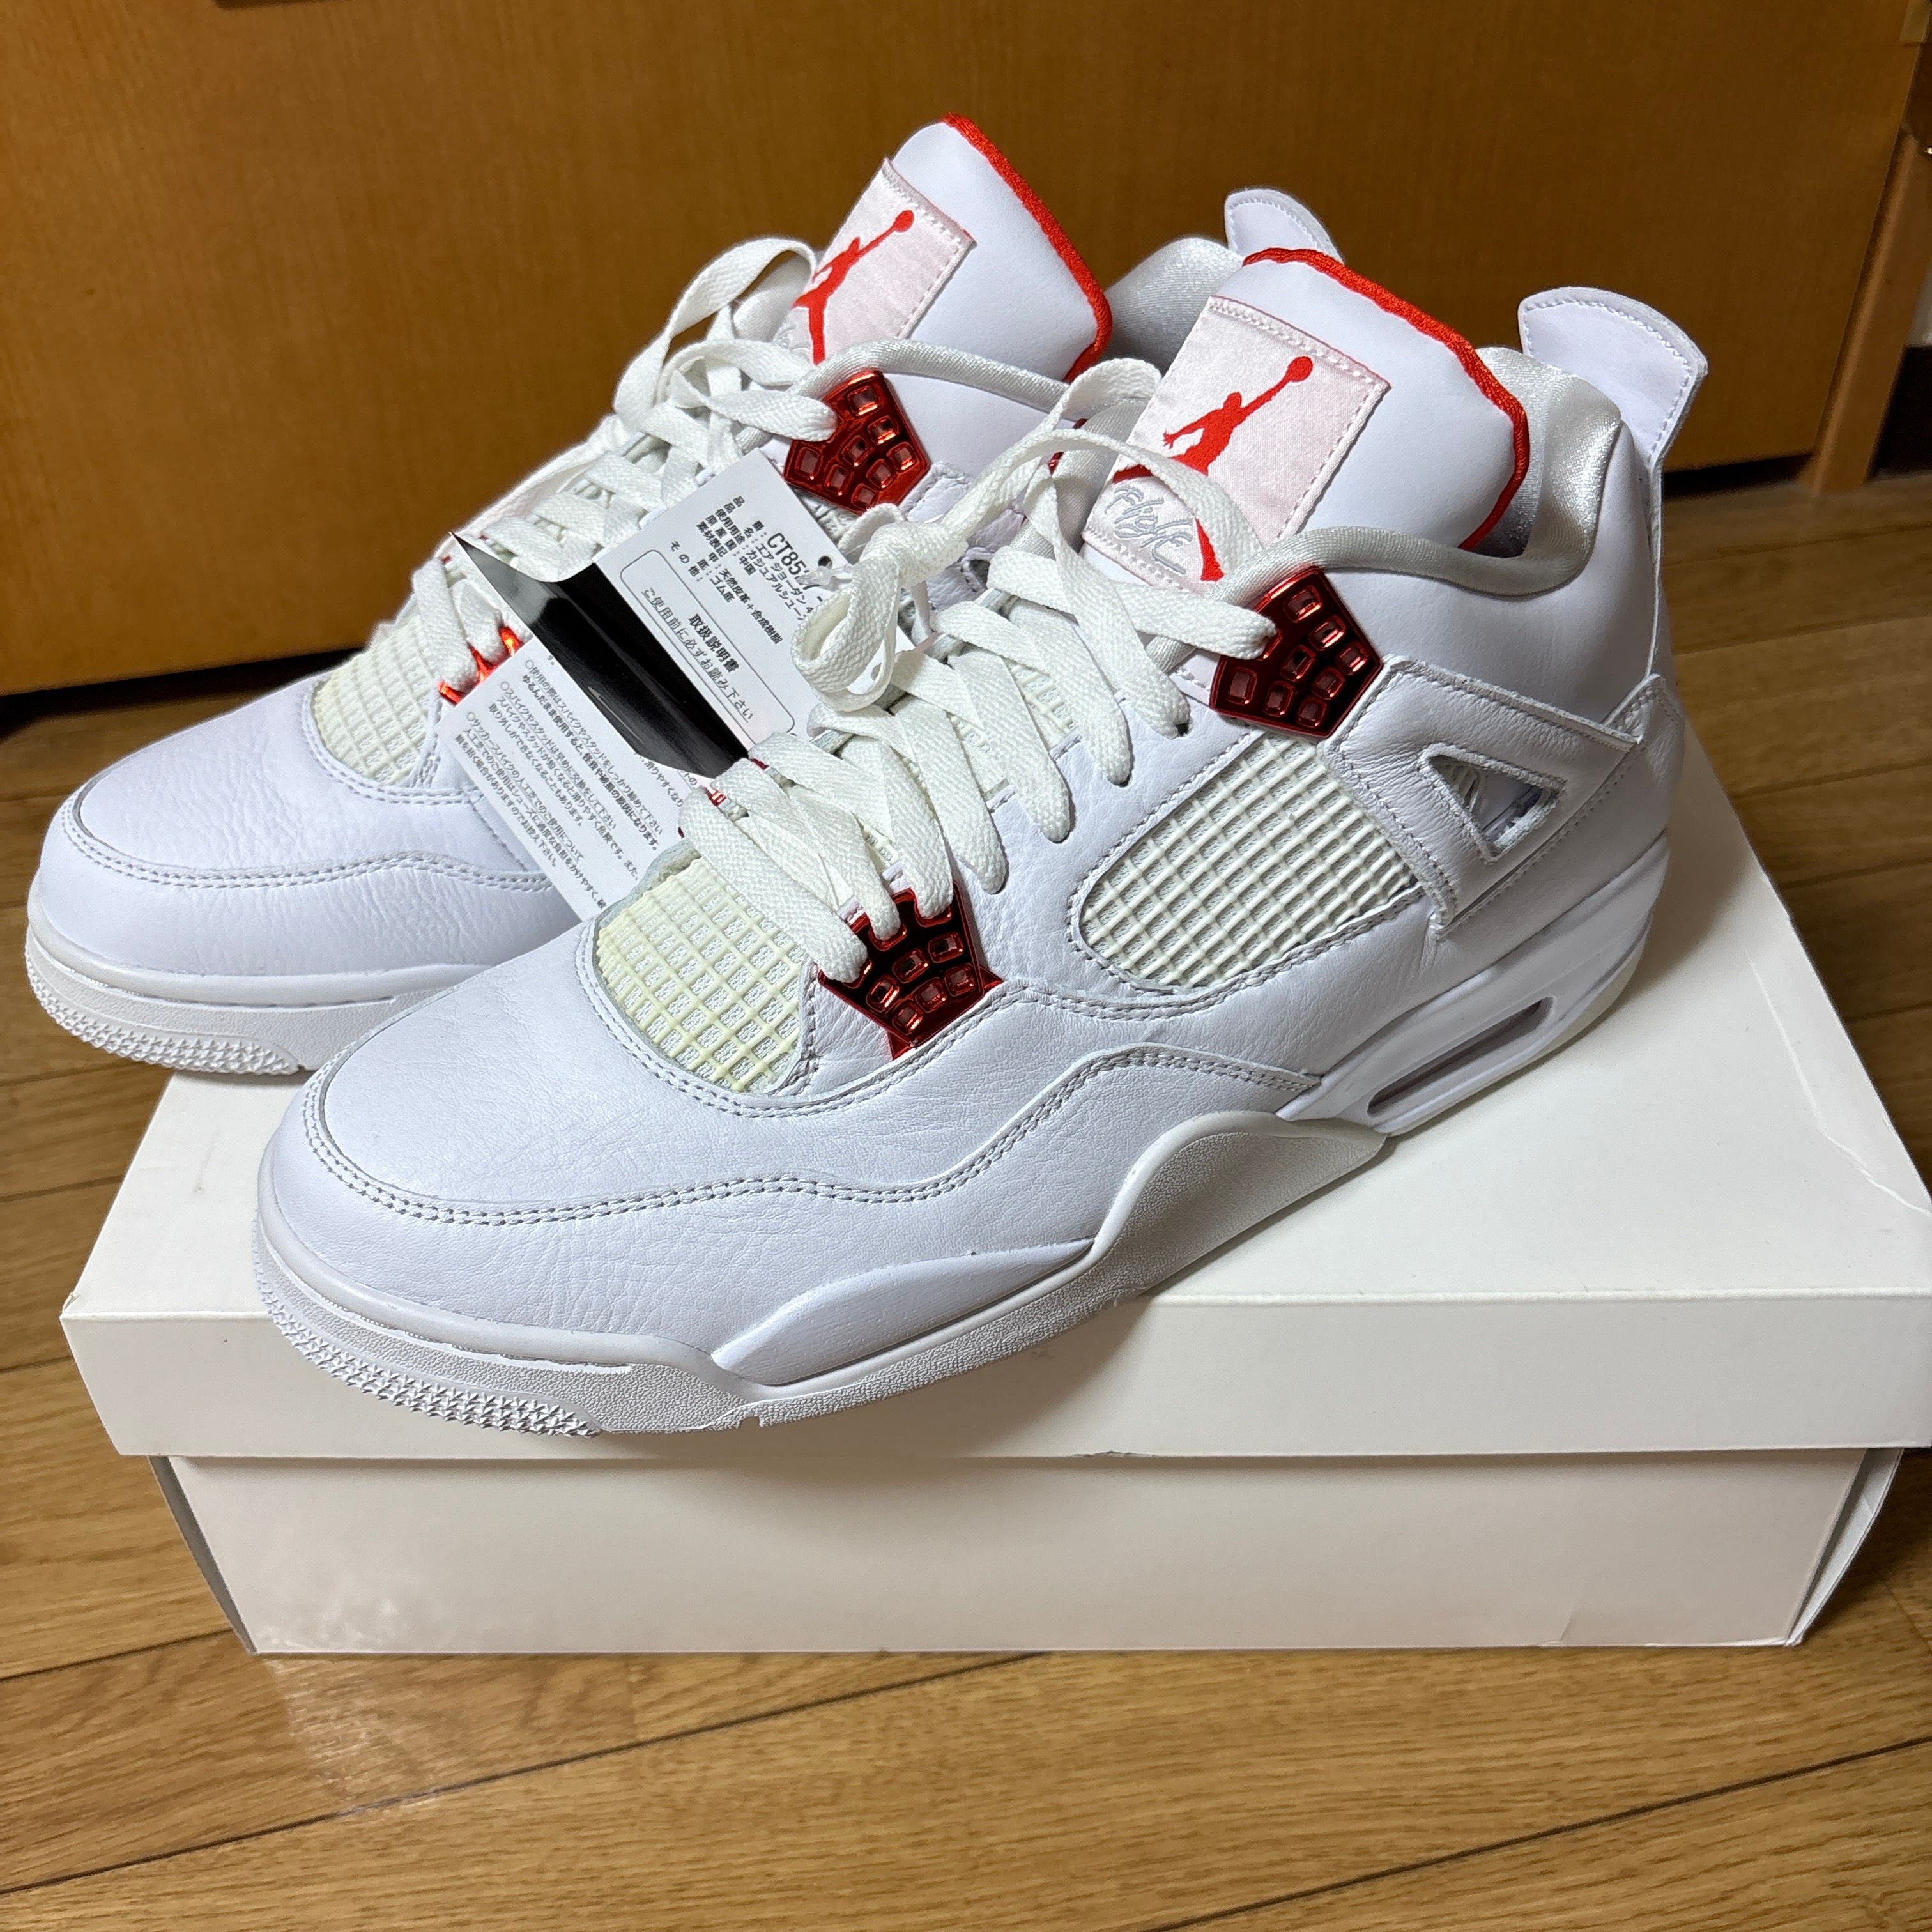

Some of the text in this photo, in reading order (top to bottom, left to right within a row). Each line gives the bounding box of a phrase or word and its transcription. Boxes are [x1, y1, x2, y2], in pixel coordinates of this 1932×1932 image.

[739, 556, 756, 575] 中国
[642, 588, 753, 723] ご使用前に必ずお読み下さい
[689, 614, 739, 672] 取扱説明書
